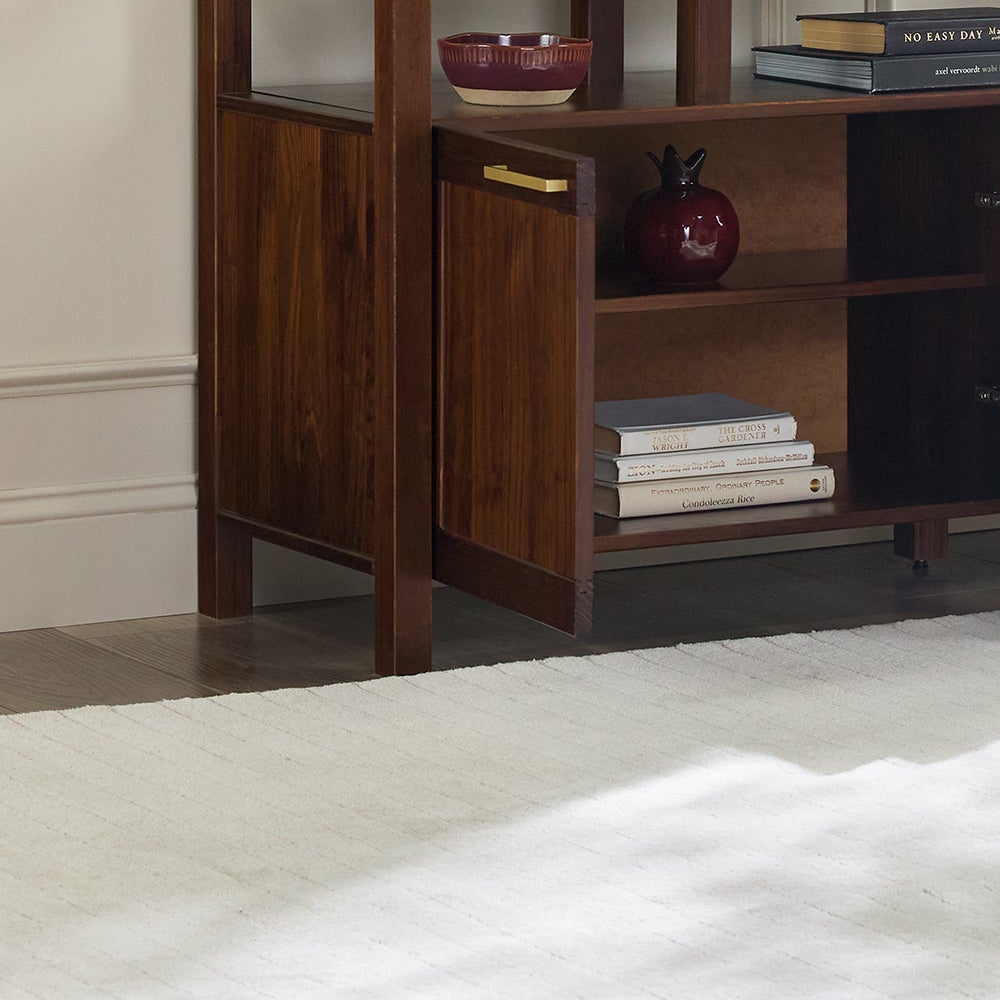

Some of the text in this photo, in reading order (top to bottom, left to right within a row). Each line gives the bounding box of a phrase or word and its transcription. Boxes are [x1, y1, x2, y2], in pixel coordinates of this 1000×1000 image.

[904, 30, 983, 42] NO EASY DAY
[934, 67, 949, 75] axel
[949, 65, 980, 75] vervoordt
[981, 64, 998, 73] wabi
[719, 425, 736, 435] THE
[738, 423, 766, 433] CROSS
[652, 434, 680, 444] JASON
[718, 432, 766, 443] GARDENER
[652, 441, 689, 451] WRIGHT
[715, 481, 753, 490] ORDINARY
[754, 478, 785, 487] PEOPLE
[681, 494, 756, 509] Condoleezza Rice
